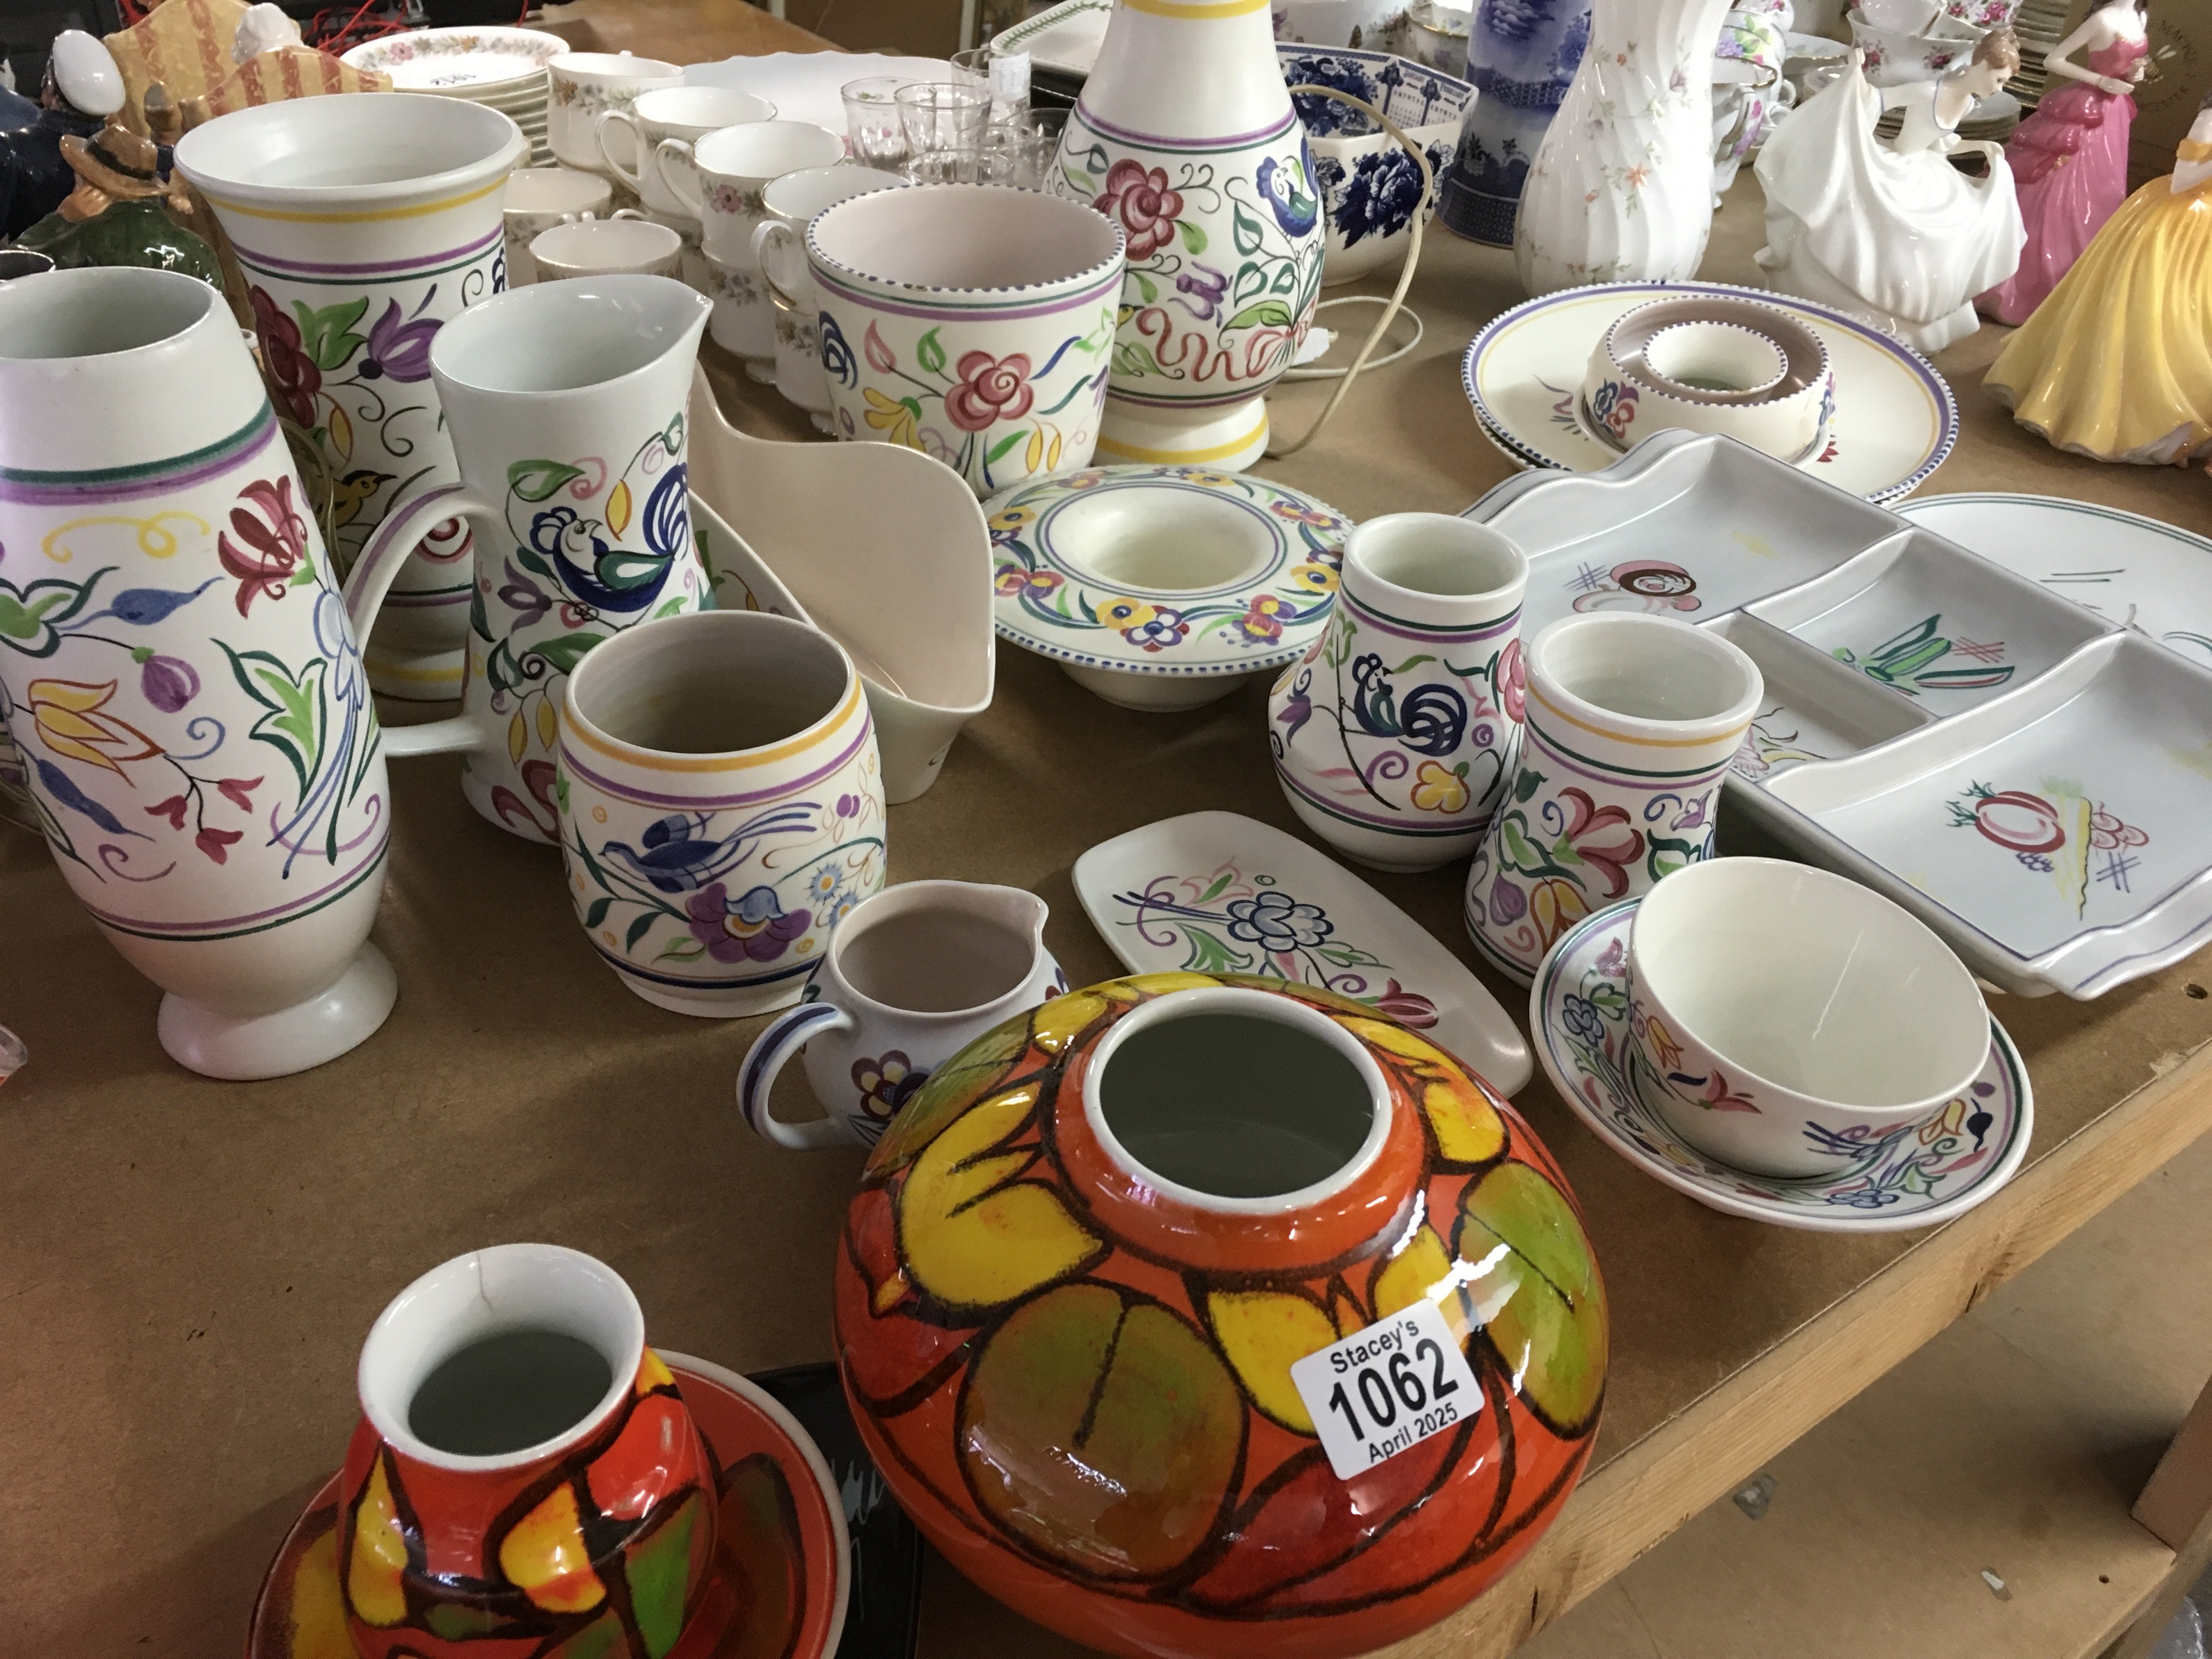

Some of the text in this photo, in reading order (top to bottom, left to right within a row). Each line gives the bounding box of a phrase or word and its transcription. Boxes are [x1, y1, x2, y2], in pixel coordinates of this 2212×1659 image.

[1330, 1320, 1420, 1374] Stacey's
[1329, 1338, 1459, 1442] 1062
[1368, 1402, 1458, 1463] April 2025
